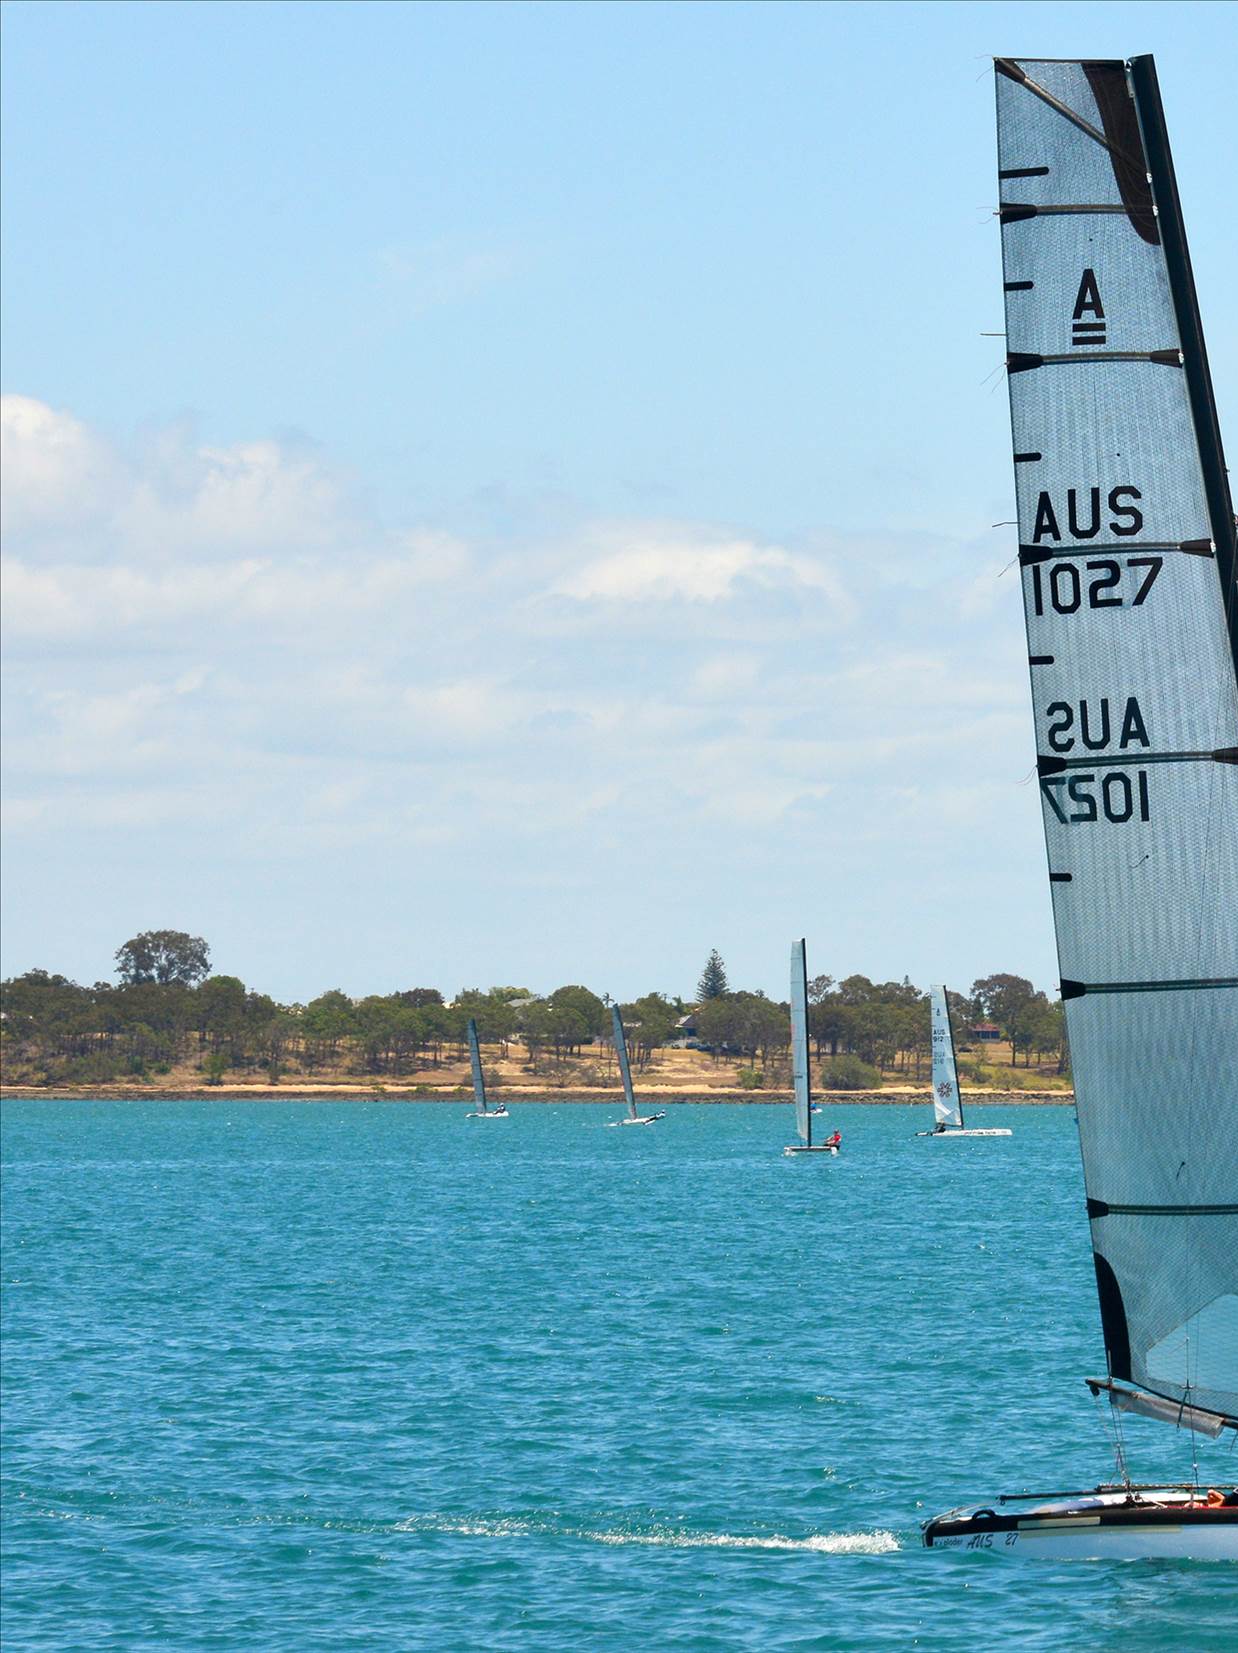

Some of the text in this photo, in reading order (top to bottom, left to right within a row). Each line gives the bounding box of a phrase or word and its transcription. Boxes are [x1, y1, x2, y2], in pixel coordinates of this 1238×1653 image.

[1072, 268, 1106, 321] A
[1032, 485, 1144, 544] AUS
[1033, 557, 1163, 616] 1027
